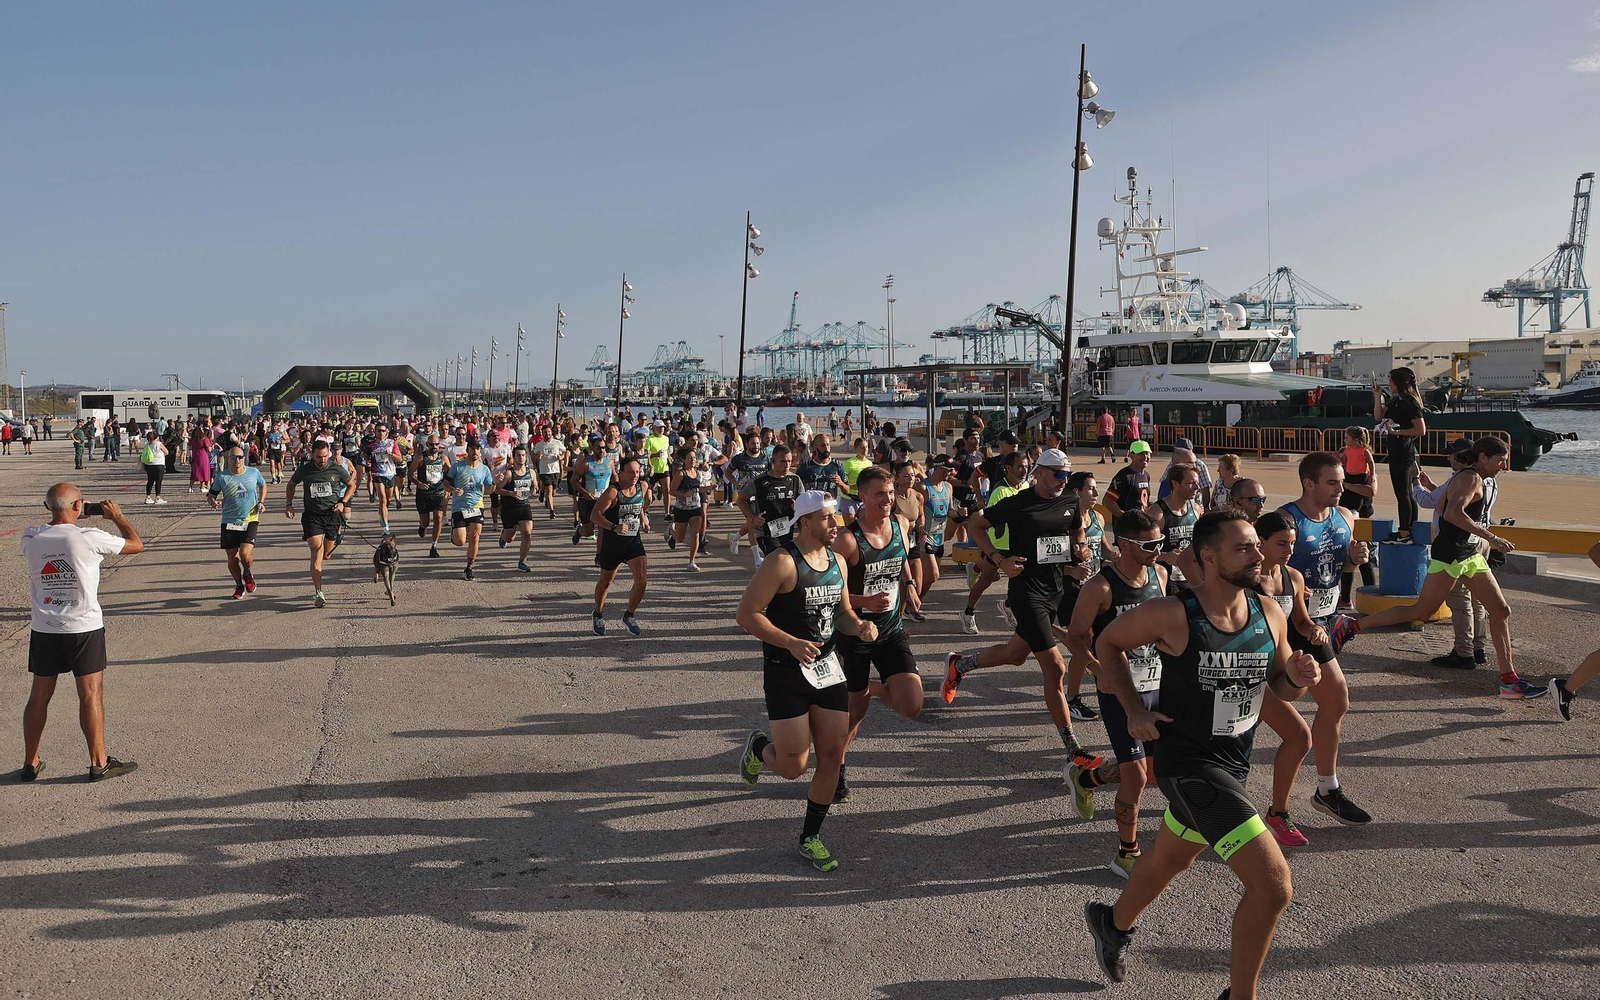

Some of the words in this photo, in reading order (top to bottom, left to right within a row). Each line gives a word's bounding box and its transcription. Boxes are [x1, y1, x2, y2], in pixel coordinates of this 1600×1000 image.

[335, 372, 372, 382] 42K
[1169, 526, 1186, 534] XXVI
[1046, 544, 1062, 554] 203
[865, 561, 885, 572] XXVI
[804, 586, 828, 598] XXVI
[1319, 596, 1333, 607] 204
[1198, 651, 1238, 668] XXVI
[812, 662, 831, 677] 198
[1147, 667, 1157, 678] 77
[1200, 668, 1227, 678] VIRGEN
[1230, 669, 1242, 677] DEL
[1202, 684, 1214, 692] CIVIL
[1222, 690, 1250, 698] XXVI
[1238, 700, 1252, 718] 16
